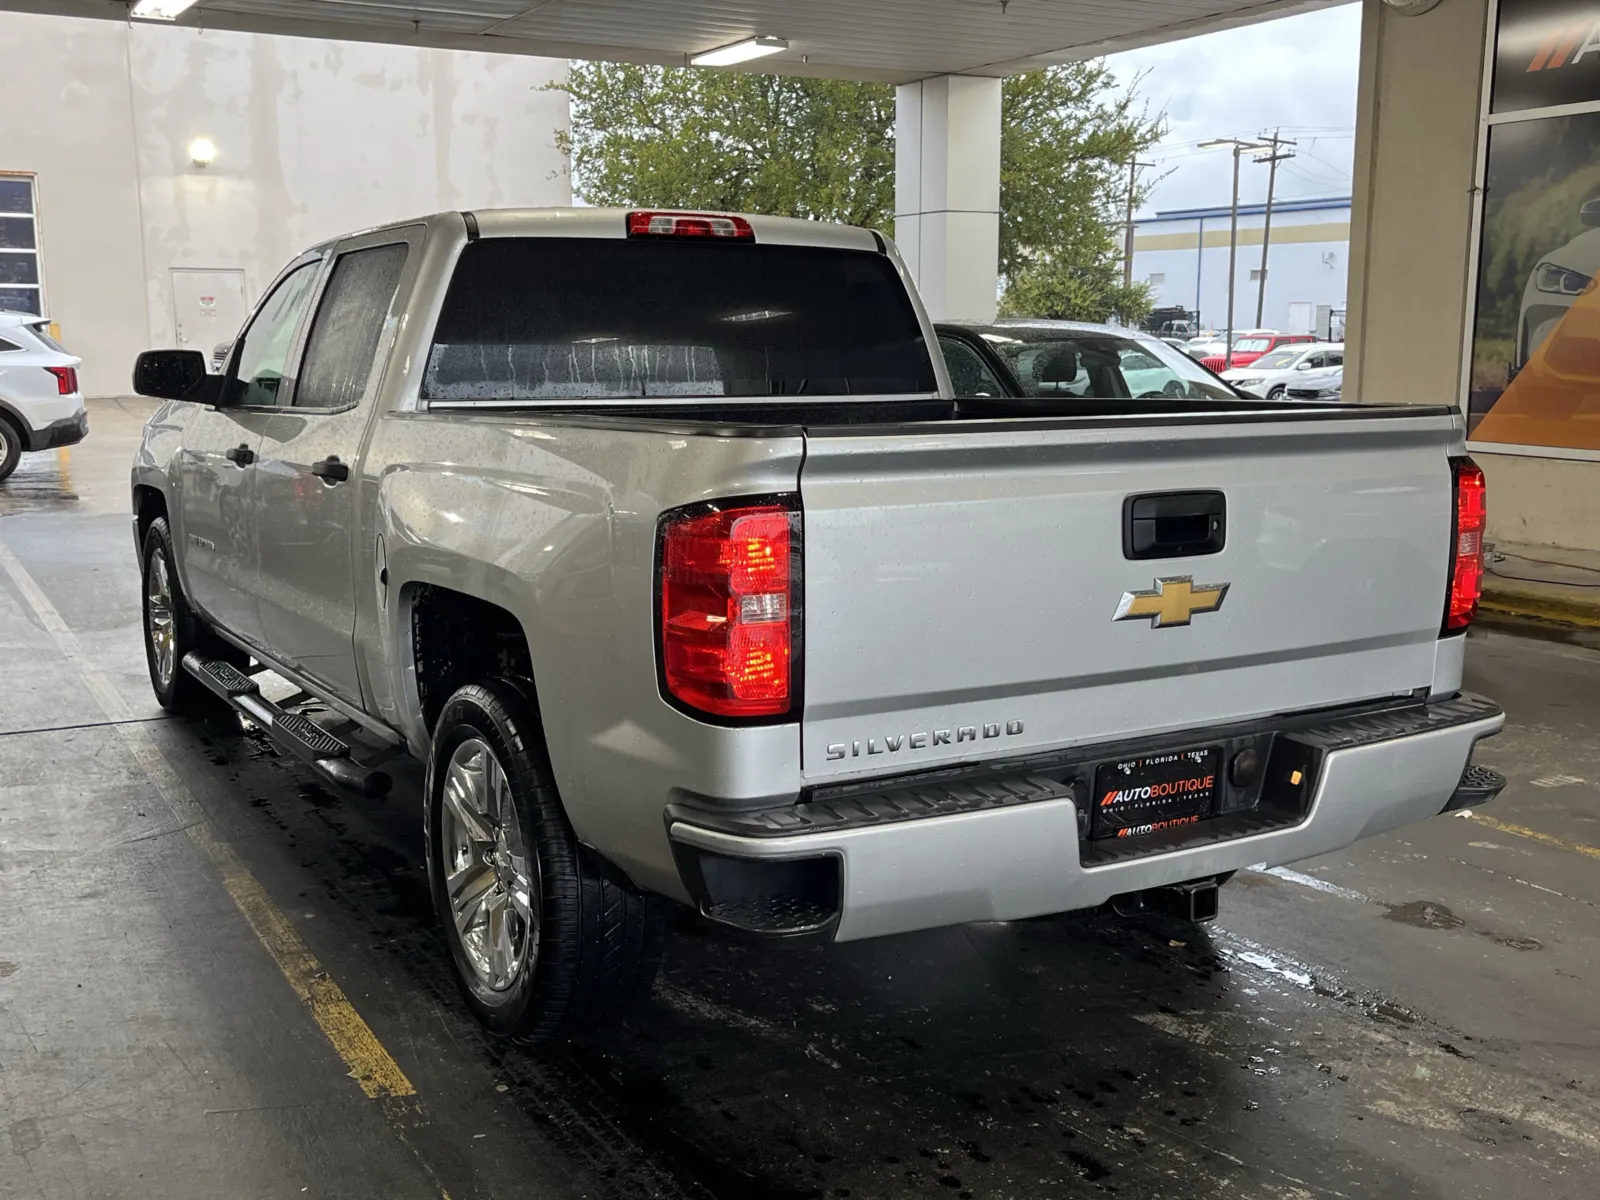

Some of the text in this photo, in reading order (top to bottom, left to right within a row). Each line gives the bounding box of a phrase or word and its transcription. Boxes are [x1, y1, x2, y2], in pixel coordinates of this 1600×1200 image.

[826, 719, 1025, 761] SILVERADO
[1117, 749, 1209, 770] OHIO FLORIDA TEXAS
[1113, 775, 1214, 803] AUTOBOUTIQUE
[1102, 791, 1209, 814] OHIO FLORIDA TEXAS
